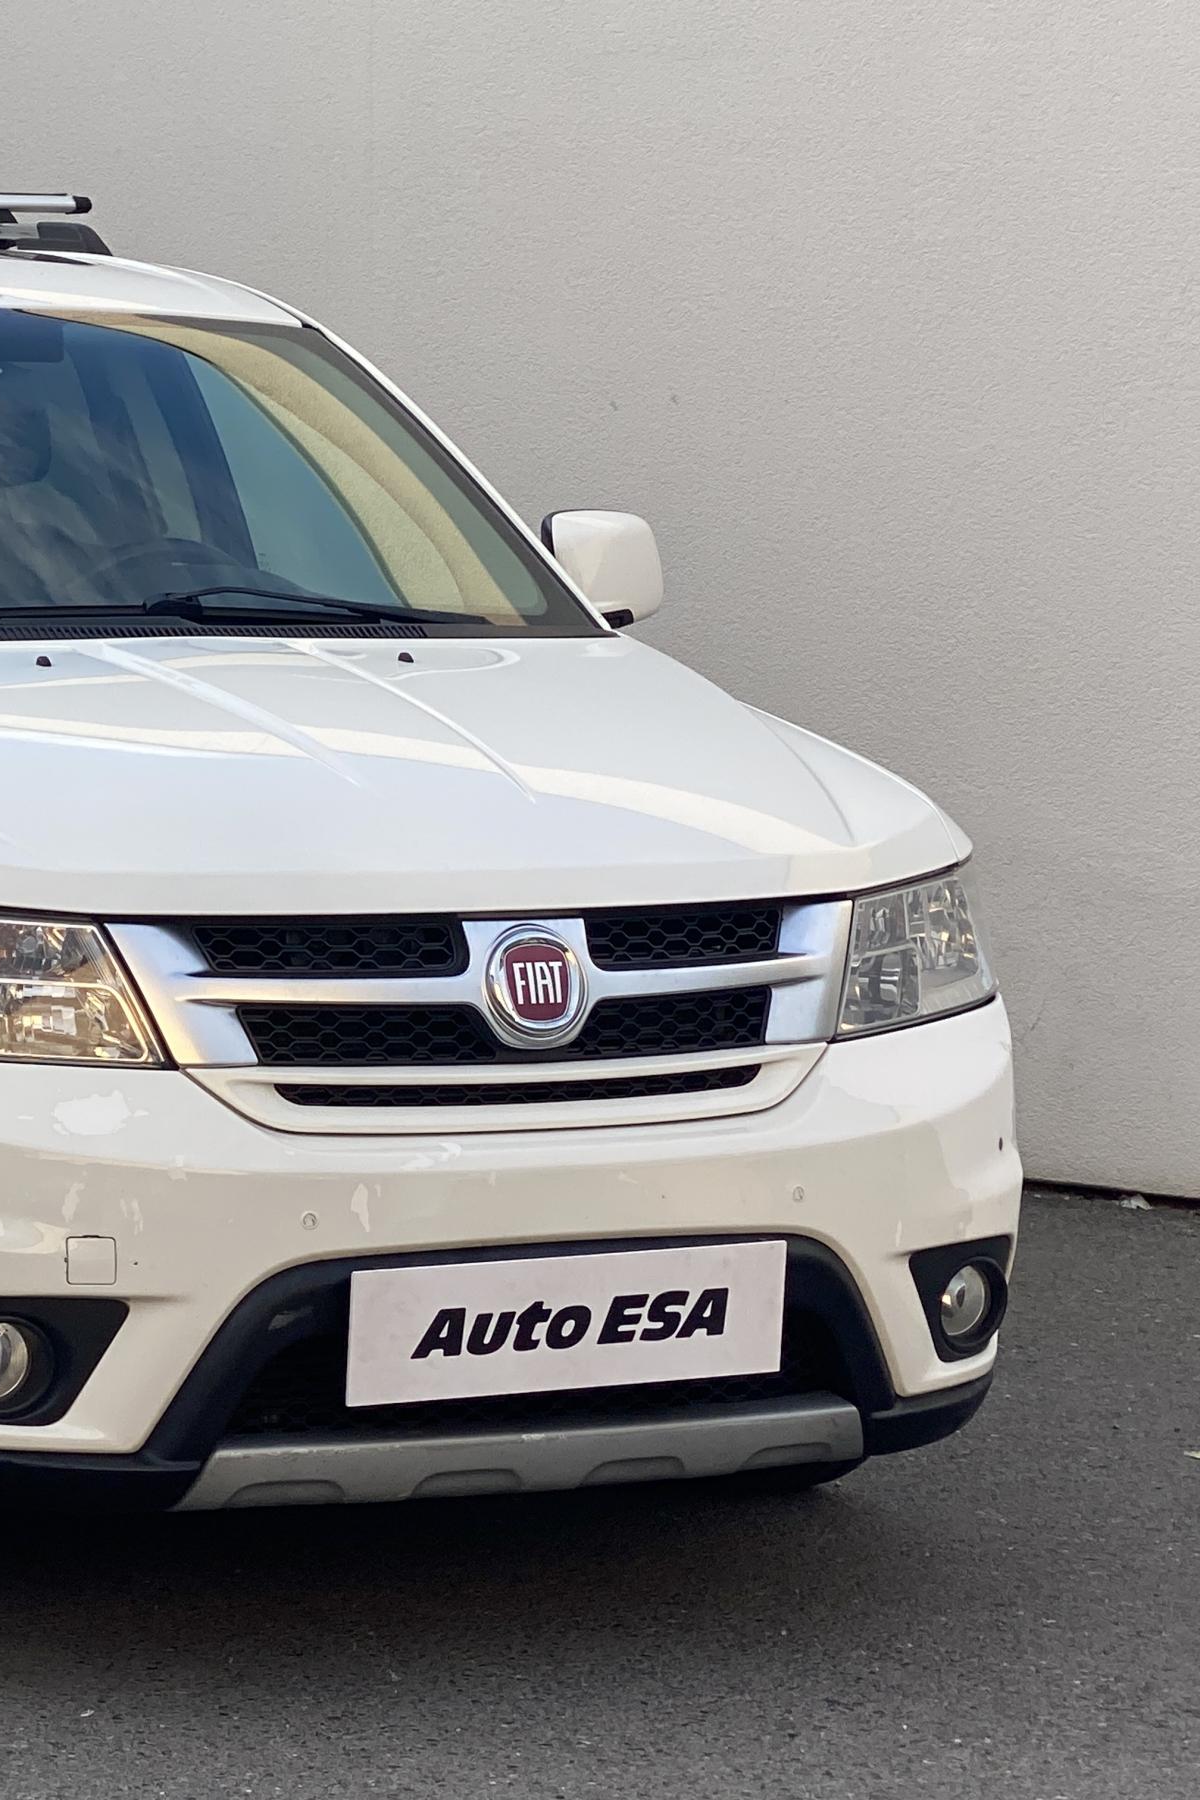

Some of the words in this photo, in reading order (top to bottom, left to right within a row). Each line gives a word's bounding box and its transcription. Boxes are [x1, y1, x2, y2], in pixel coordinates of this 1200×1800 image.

[512, 961, 563, 1005] FIAT
[410, 1300, 592, 1360] Auto
[596, 1287, 729, 1345] ESA
